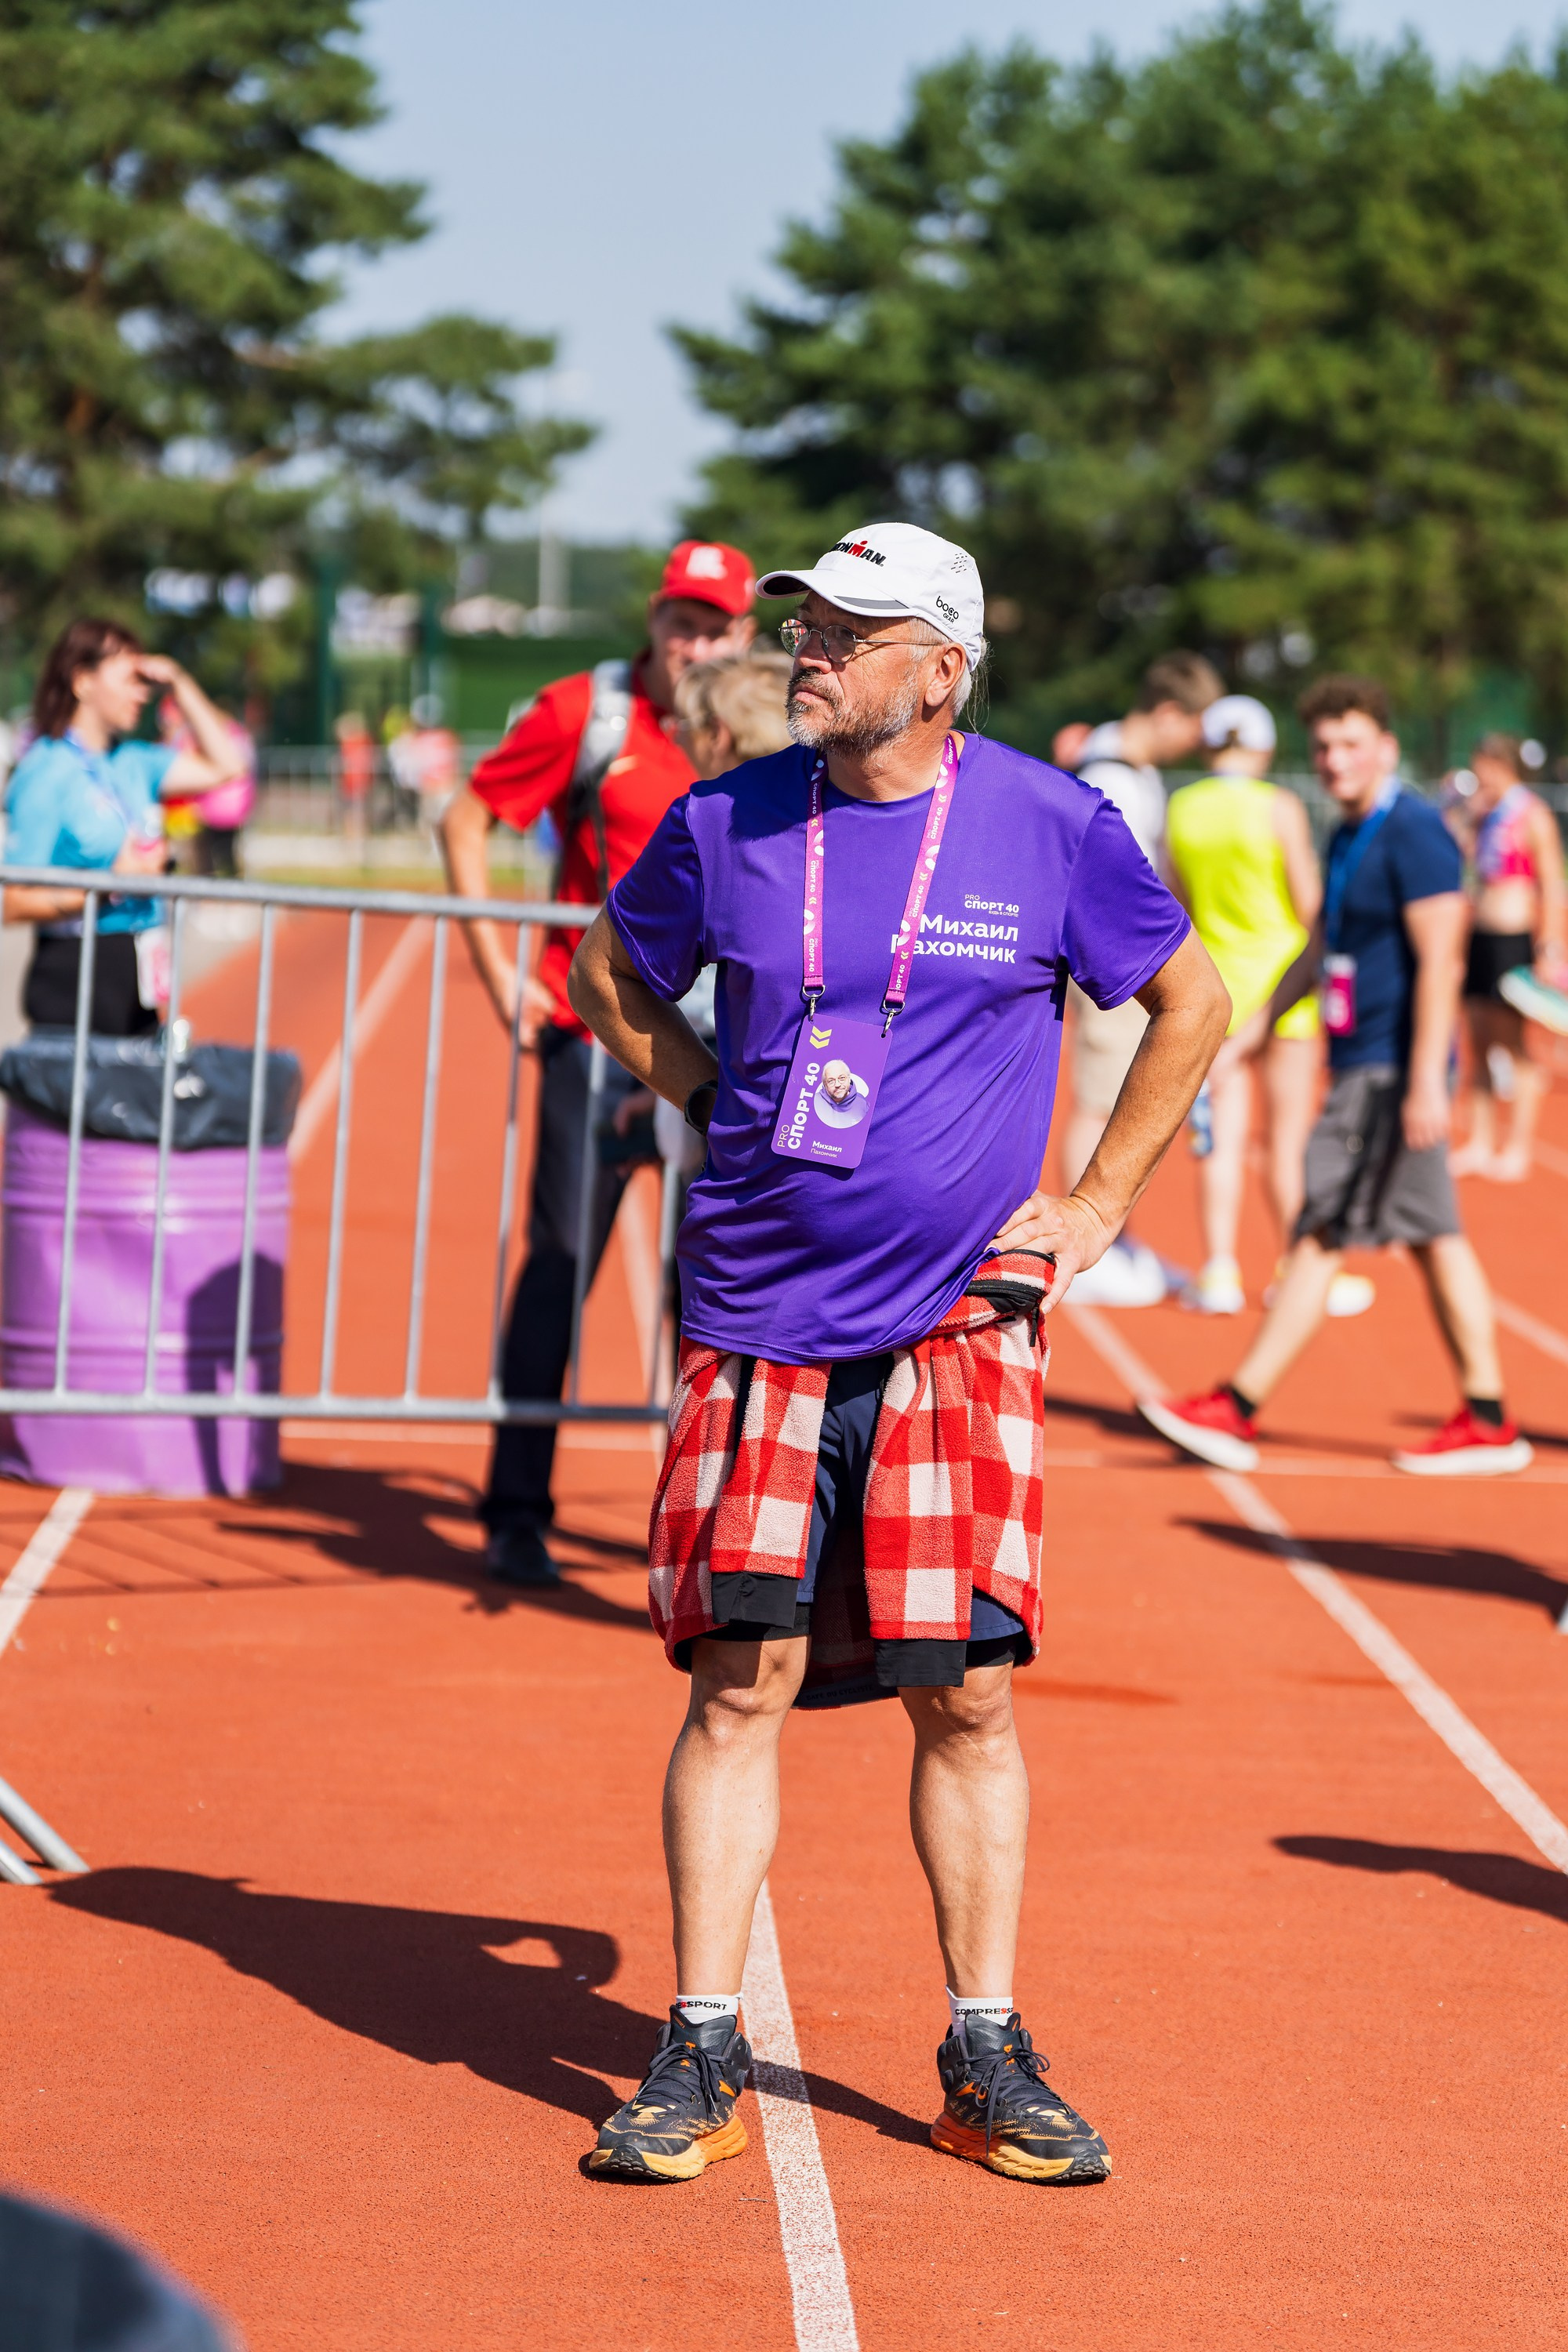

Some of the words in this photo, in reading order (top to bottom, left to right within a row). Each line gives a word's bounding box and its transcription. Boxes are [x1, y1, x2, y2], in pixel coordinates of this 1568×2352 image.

[830, 540, 887, 565] ONMAN
[943, 613, 954, 623] GEAR
[930, 816, 941, 839] СПОРТ
[936, 808, 943, 816] 40
[810, 884, 816, 892] 40
[912, 895, 922, 917] СПОРТ
[917, 885, 924, 895] 40
[964, 900, 1004, 912] СПОРТ
[1005, 903, 1019, 913] 40
[919, 913, 1019, 942] Михаил
[808, 963, 815, 972] 40
[898, 964, 906, 974] 40
[787, 1087, 814, 1149] СПОРТ
[804, 1062, 821, 1087] 40
[777, 1124, 790, 1148] PRO
[812, 1140, 843, 1152] Михаил
